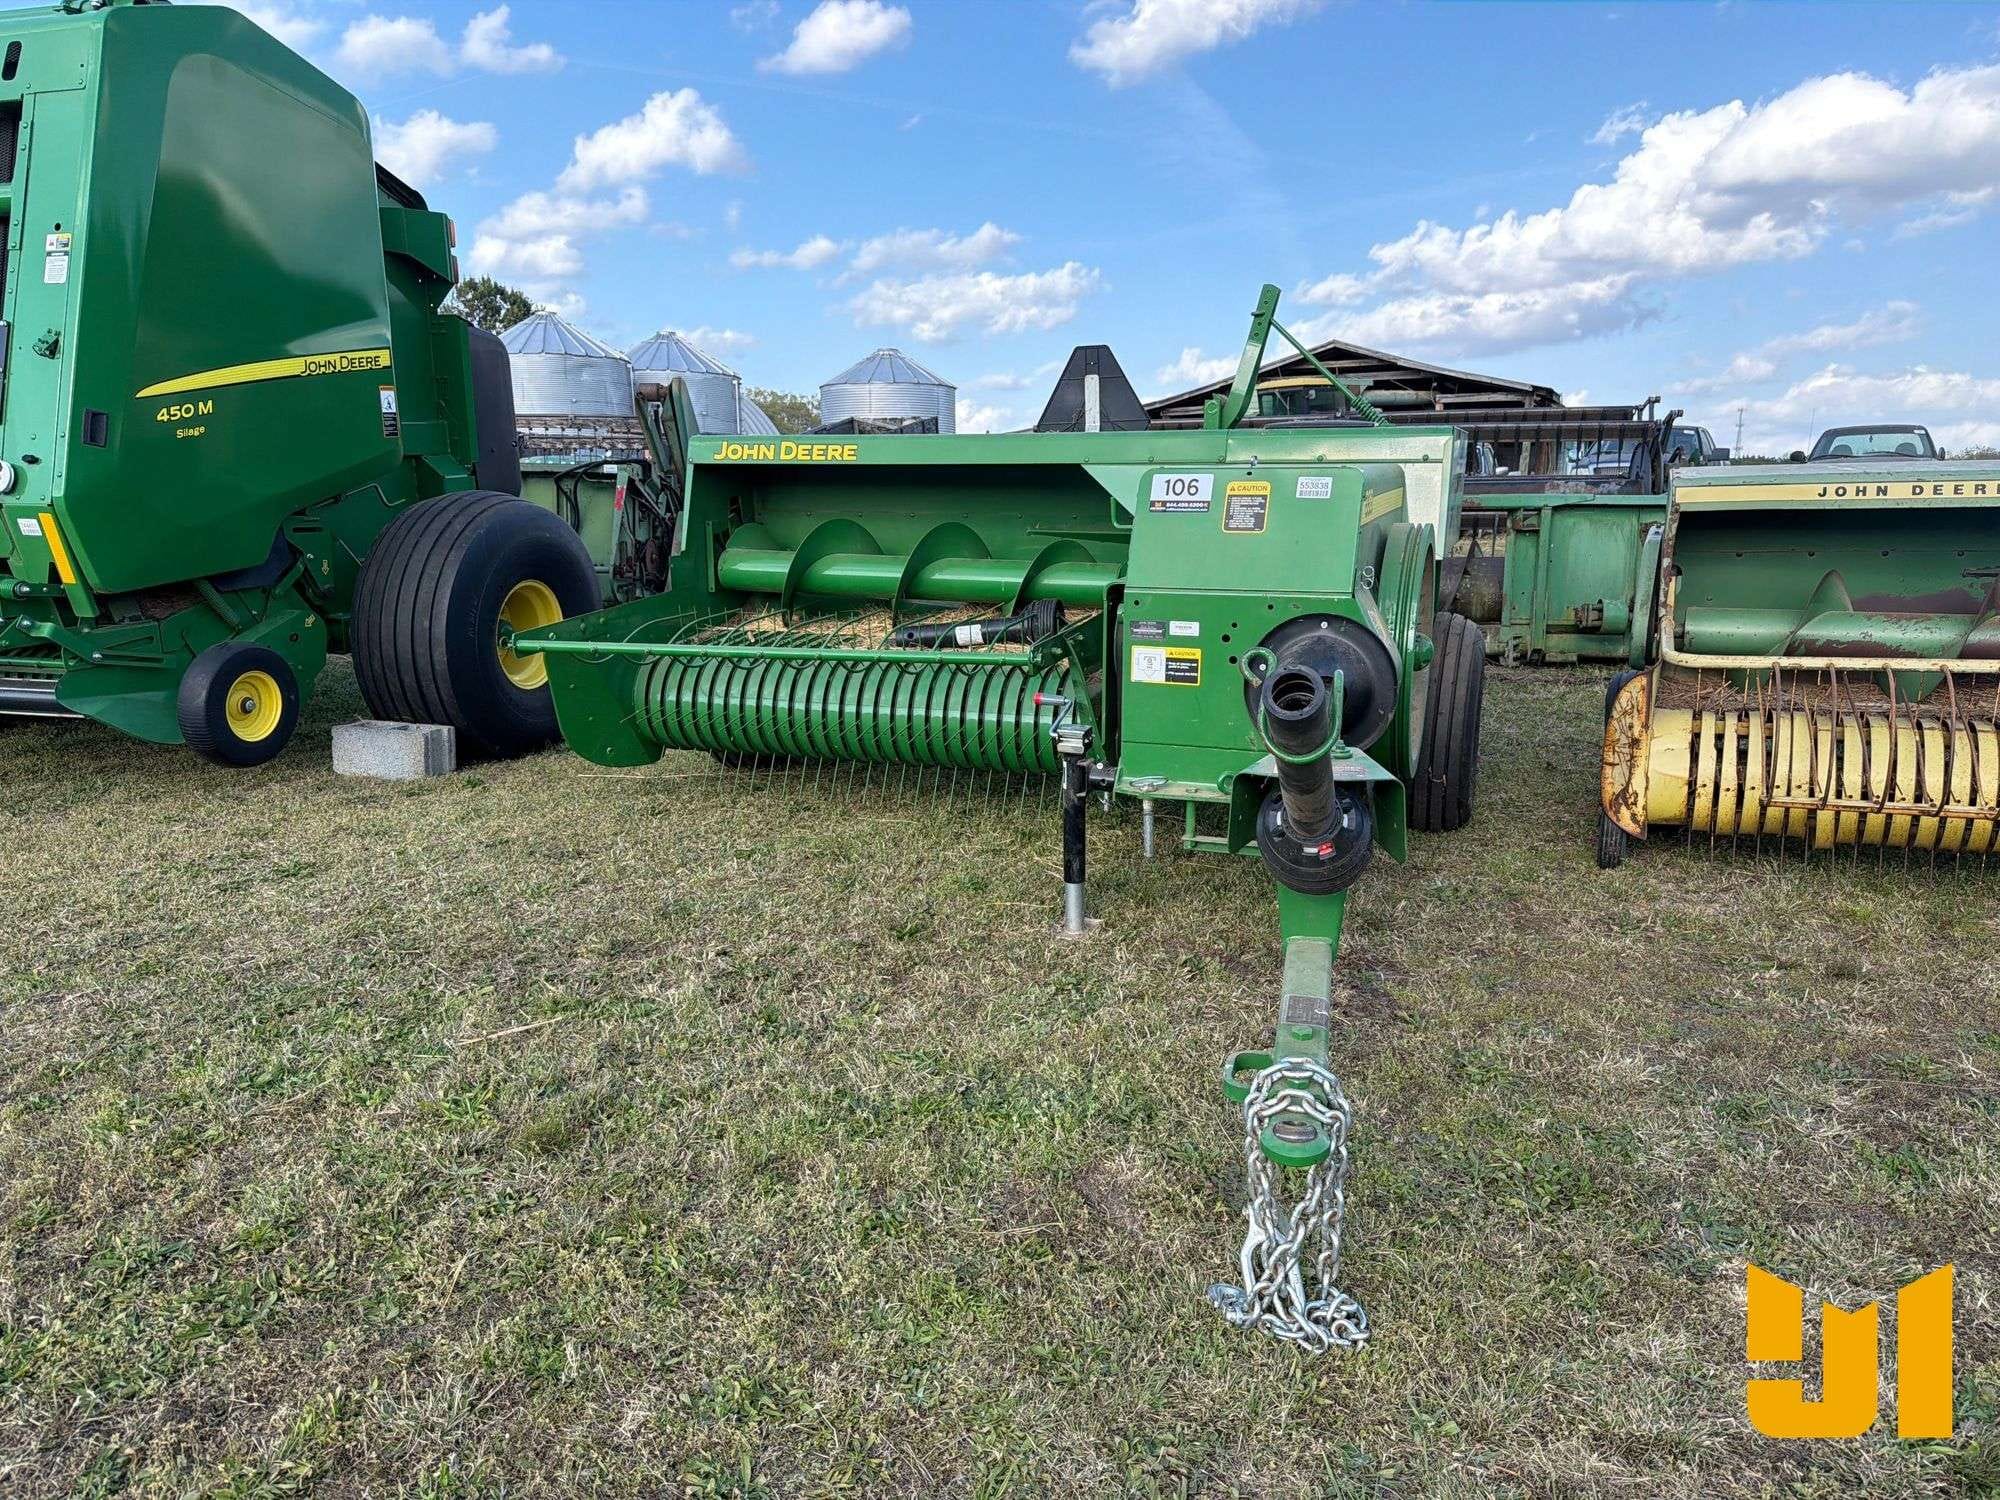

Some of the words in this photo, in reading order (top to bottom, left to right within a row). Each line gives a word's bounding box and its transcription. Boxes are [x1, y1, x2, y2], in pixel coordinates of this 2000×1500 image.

[301, 358, 337, 375] JOHN
[339, 355, 383, 370] DEERE
[156, 403, 195, 422] 450
[198, 400, 214, 415] M
[176, 425, 206, 439] Silage
[714, 441, 775, 461] JOHN
[780, 441, 858, 461] DEERE
[1165, 478, 1200, 497] 106
[1817, 485, 1889, 498] JOHN
